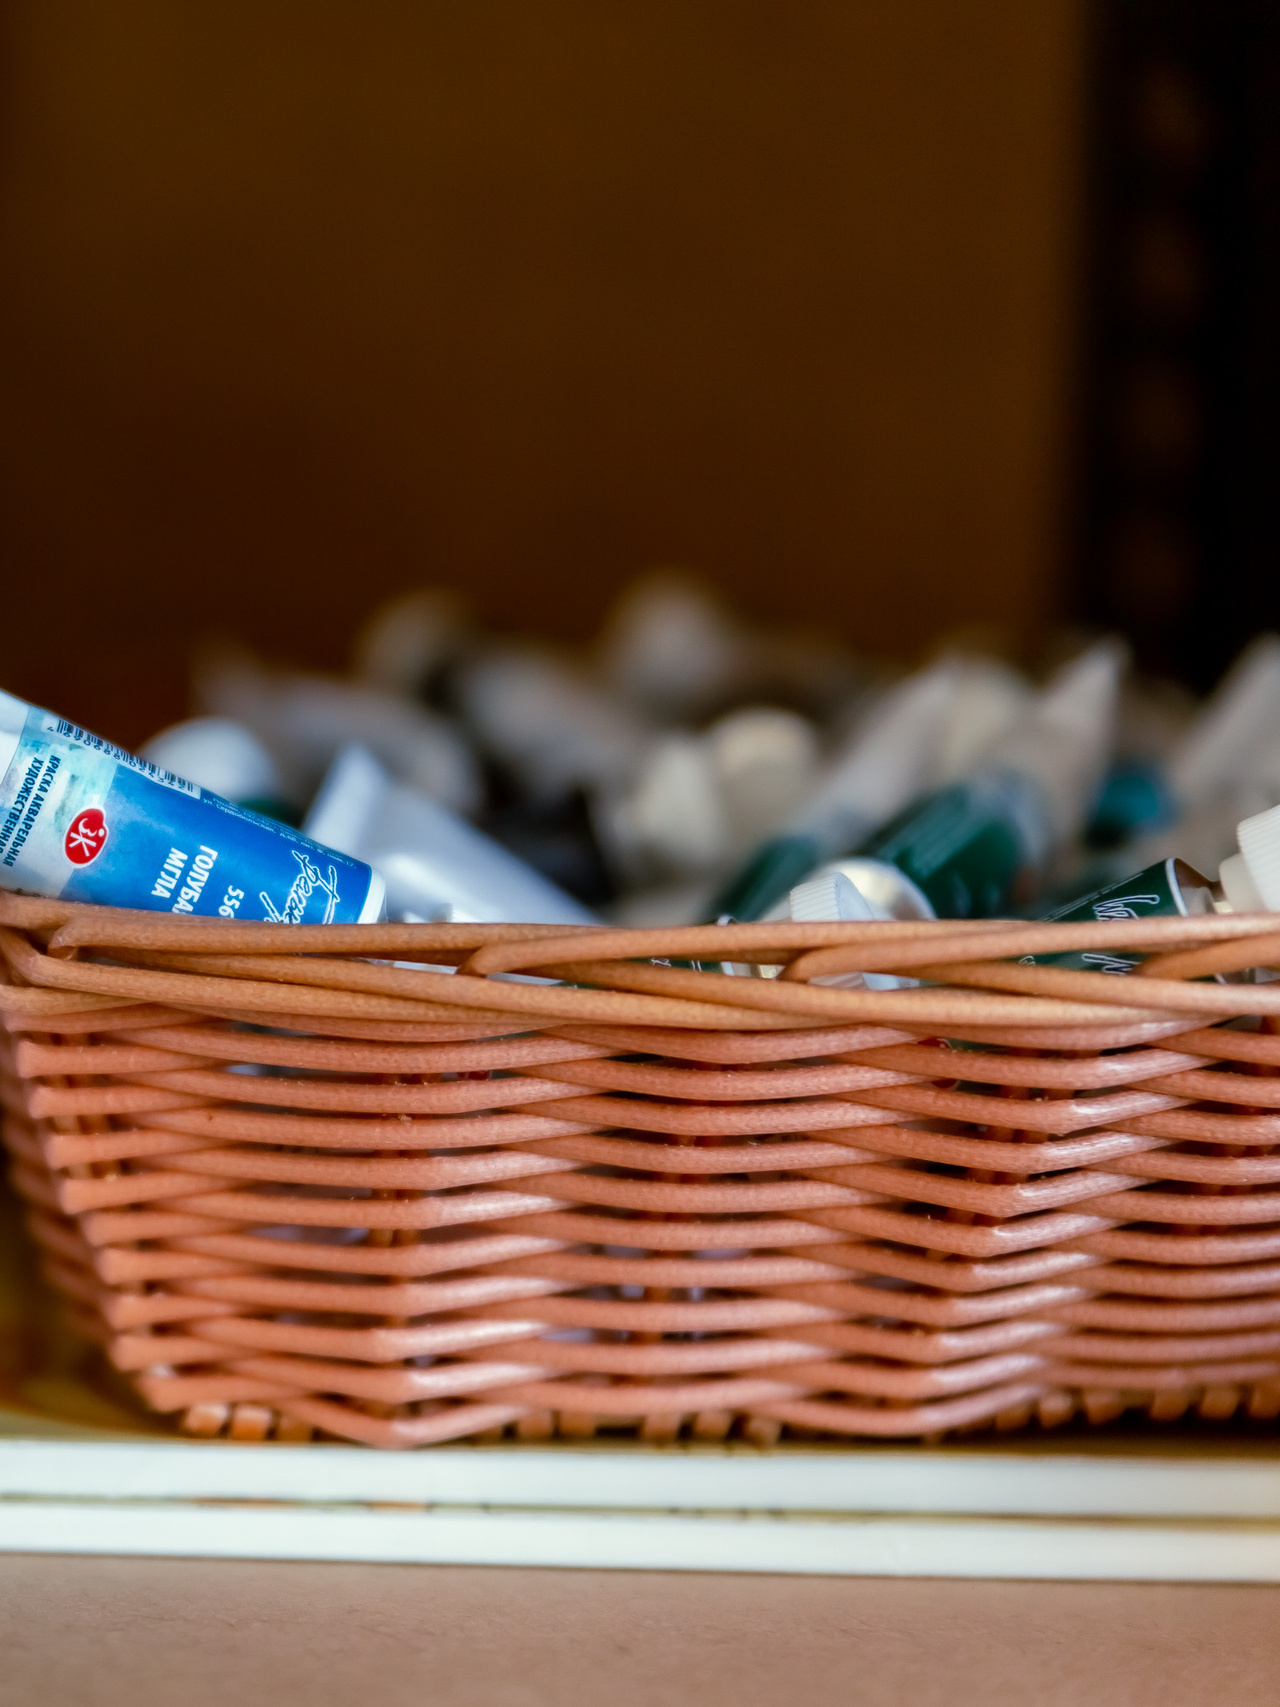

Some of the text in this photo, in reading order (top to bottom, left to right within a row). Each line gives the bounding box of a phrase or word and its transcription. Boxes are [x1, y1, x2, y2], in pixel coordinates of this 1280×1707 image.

[2, 754, 61, 867] КРАСКА АКВАРЕЛЬНАЯ
[151, 847, 188, 898] МГЛА
[171, 845, 218, 914] ГОЛУБА
[218, 885, 245, 918] 556
